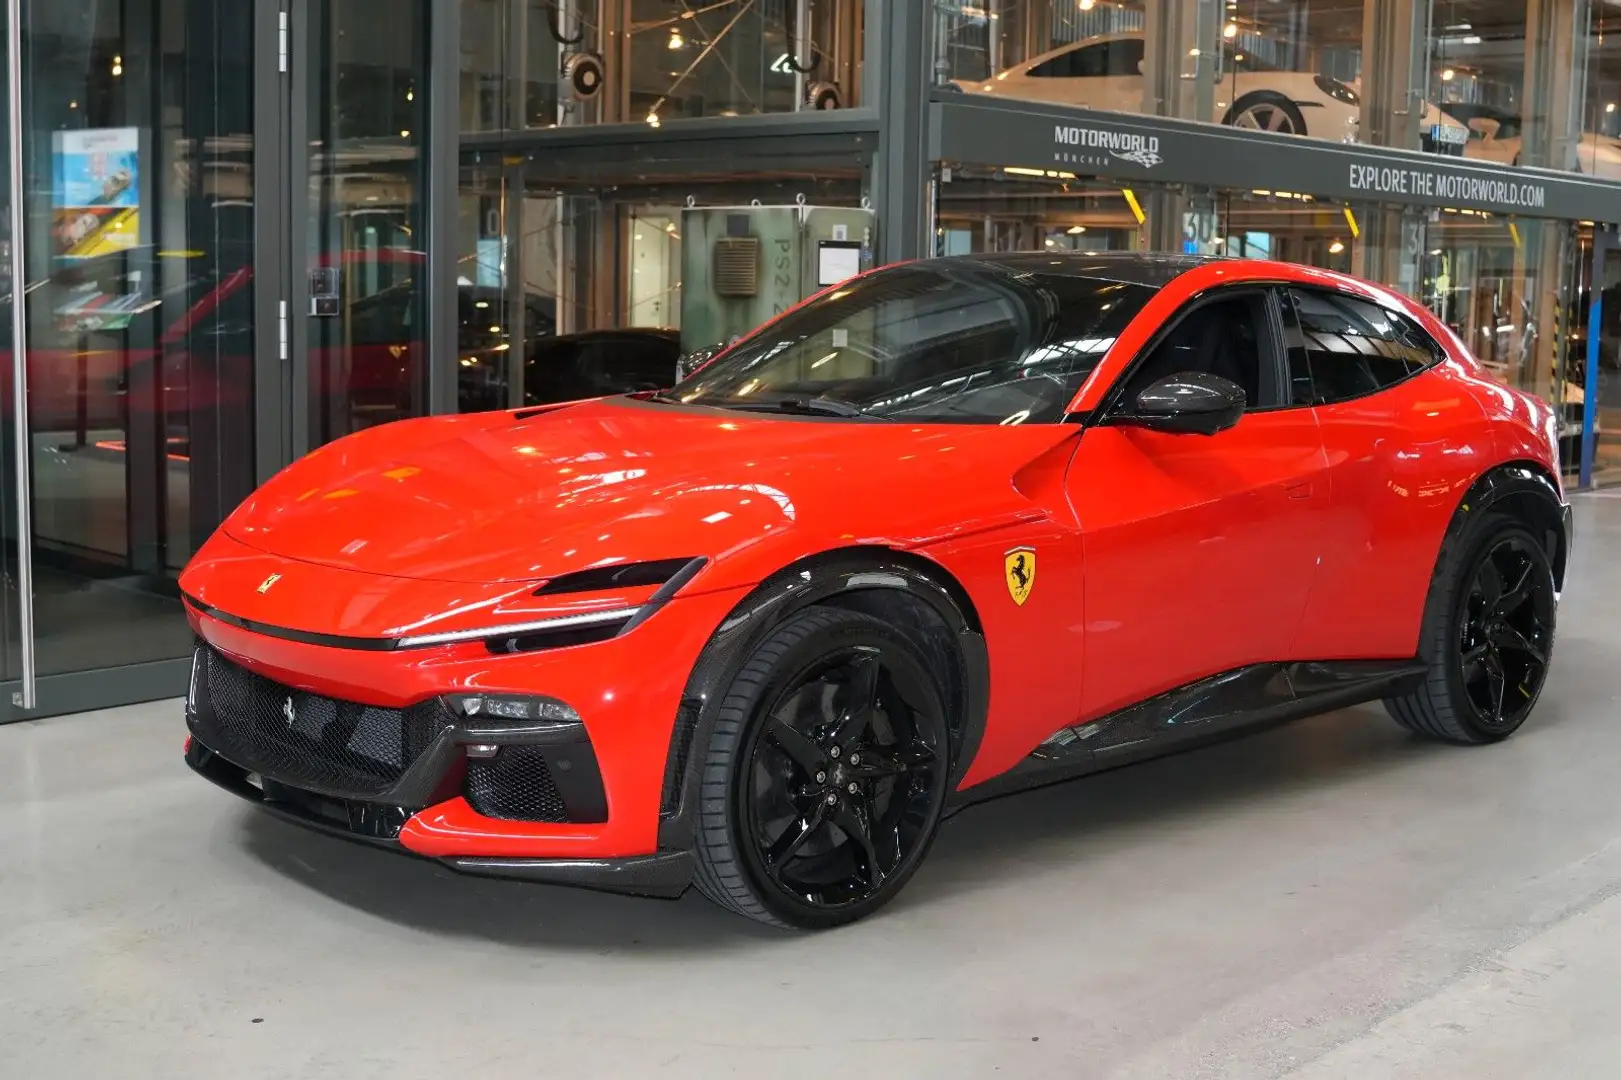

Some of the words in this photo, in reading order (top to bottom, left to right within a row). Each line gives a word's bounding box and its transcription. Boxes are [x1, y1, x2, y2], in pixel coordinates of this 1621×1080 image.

[1054, 126, 1159, 153] MOTORWORLD
[1350, 164, 1407, 193] EXPLORE
[1410, 171, 1433, 196] THE
[1436, 174, 1545, 208] MOTORWORLD.COM
